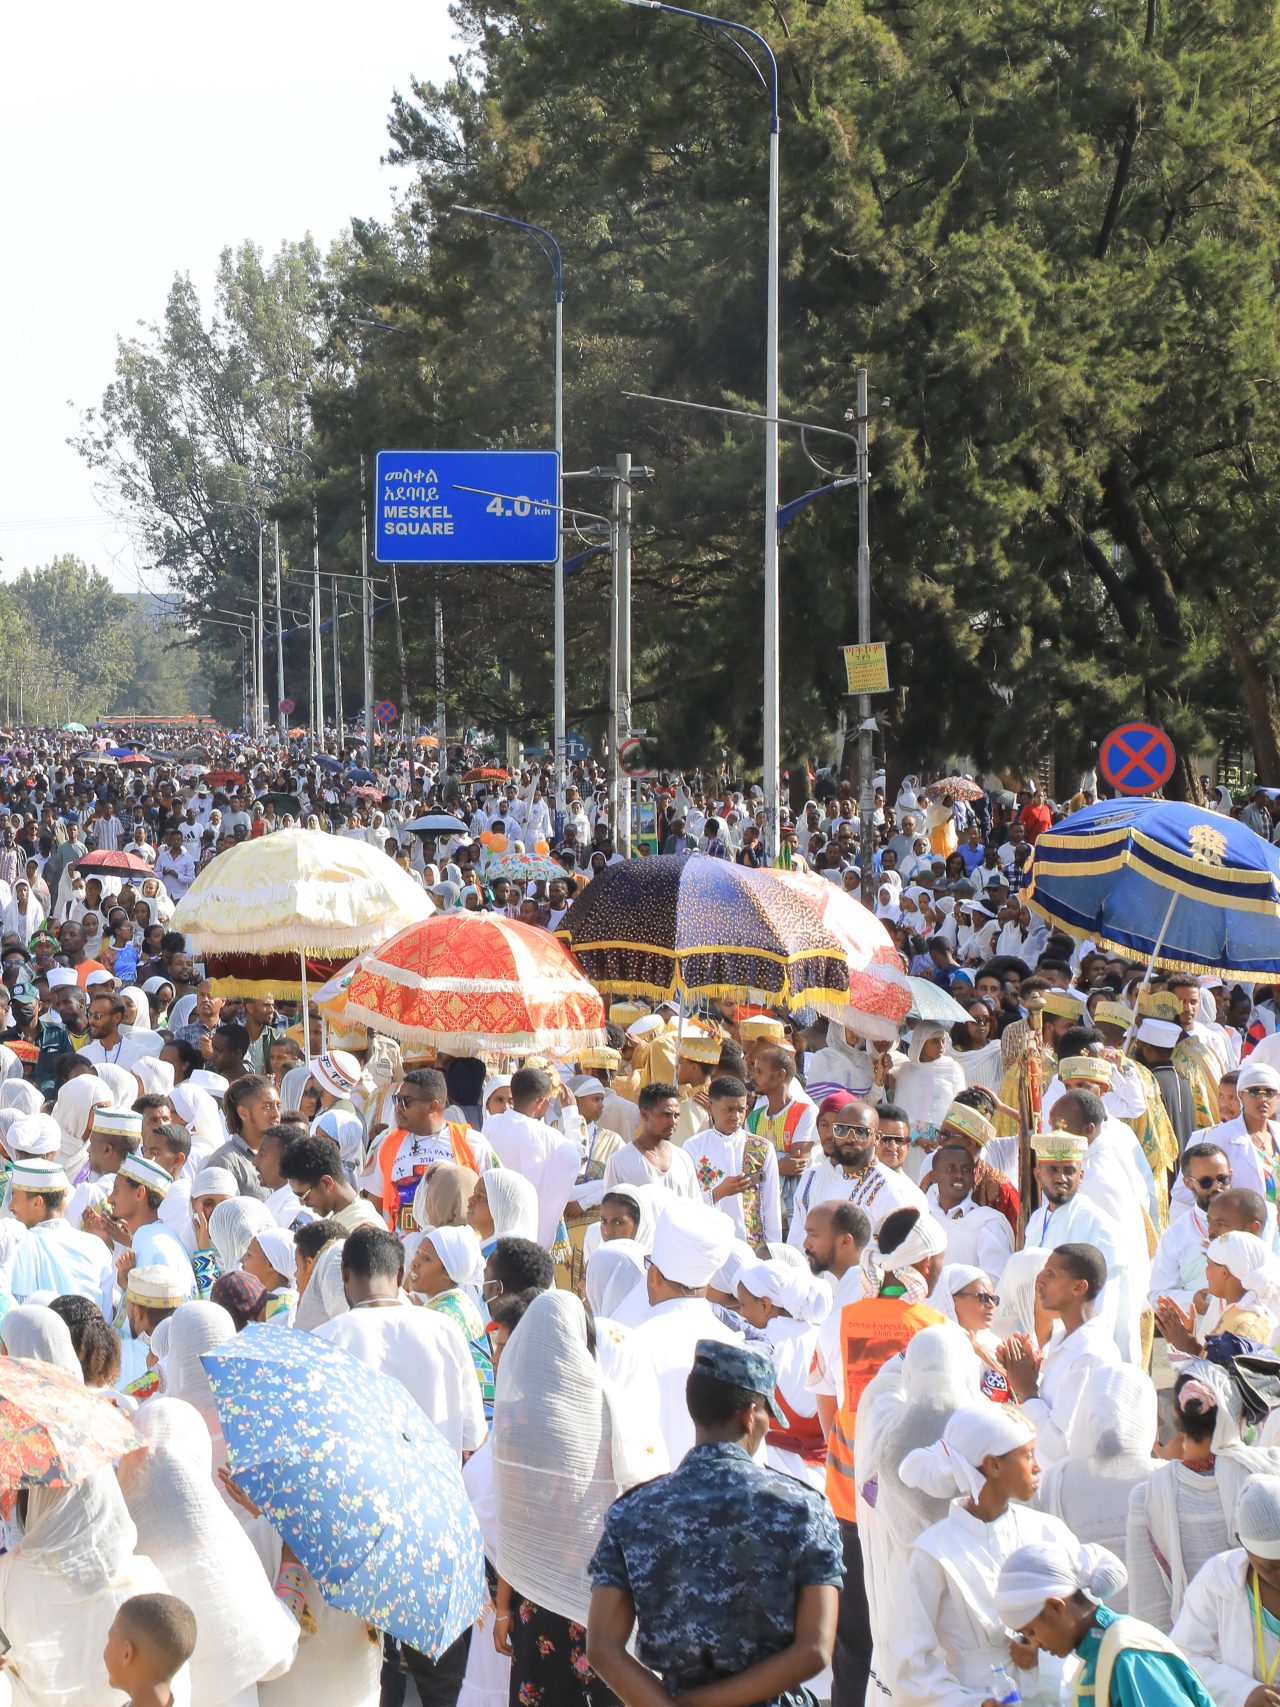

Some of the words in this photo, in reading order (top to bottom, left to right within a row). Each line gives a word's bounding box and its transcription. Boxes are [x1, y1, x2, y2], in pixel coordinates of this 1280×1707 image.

[384, 468, 439, 484] መስቀል
[384, 486, 439, 502] አደባባይ
[384, 505, 453, 519] MESKEL
[486, 495, 531, 517] 4.0
[534, 506, 551, 516] km
[384, 522, 455, 536] SQUARE
